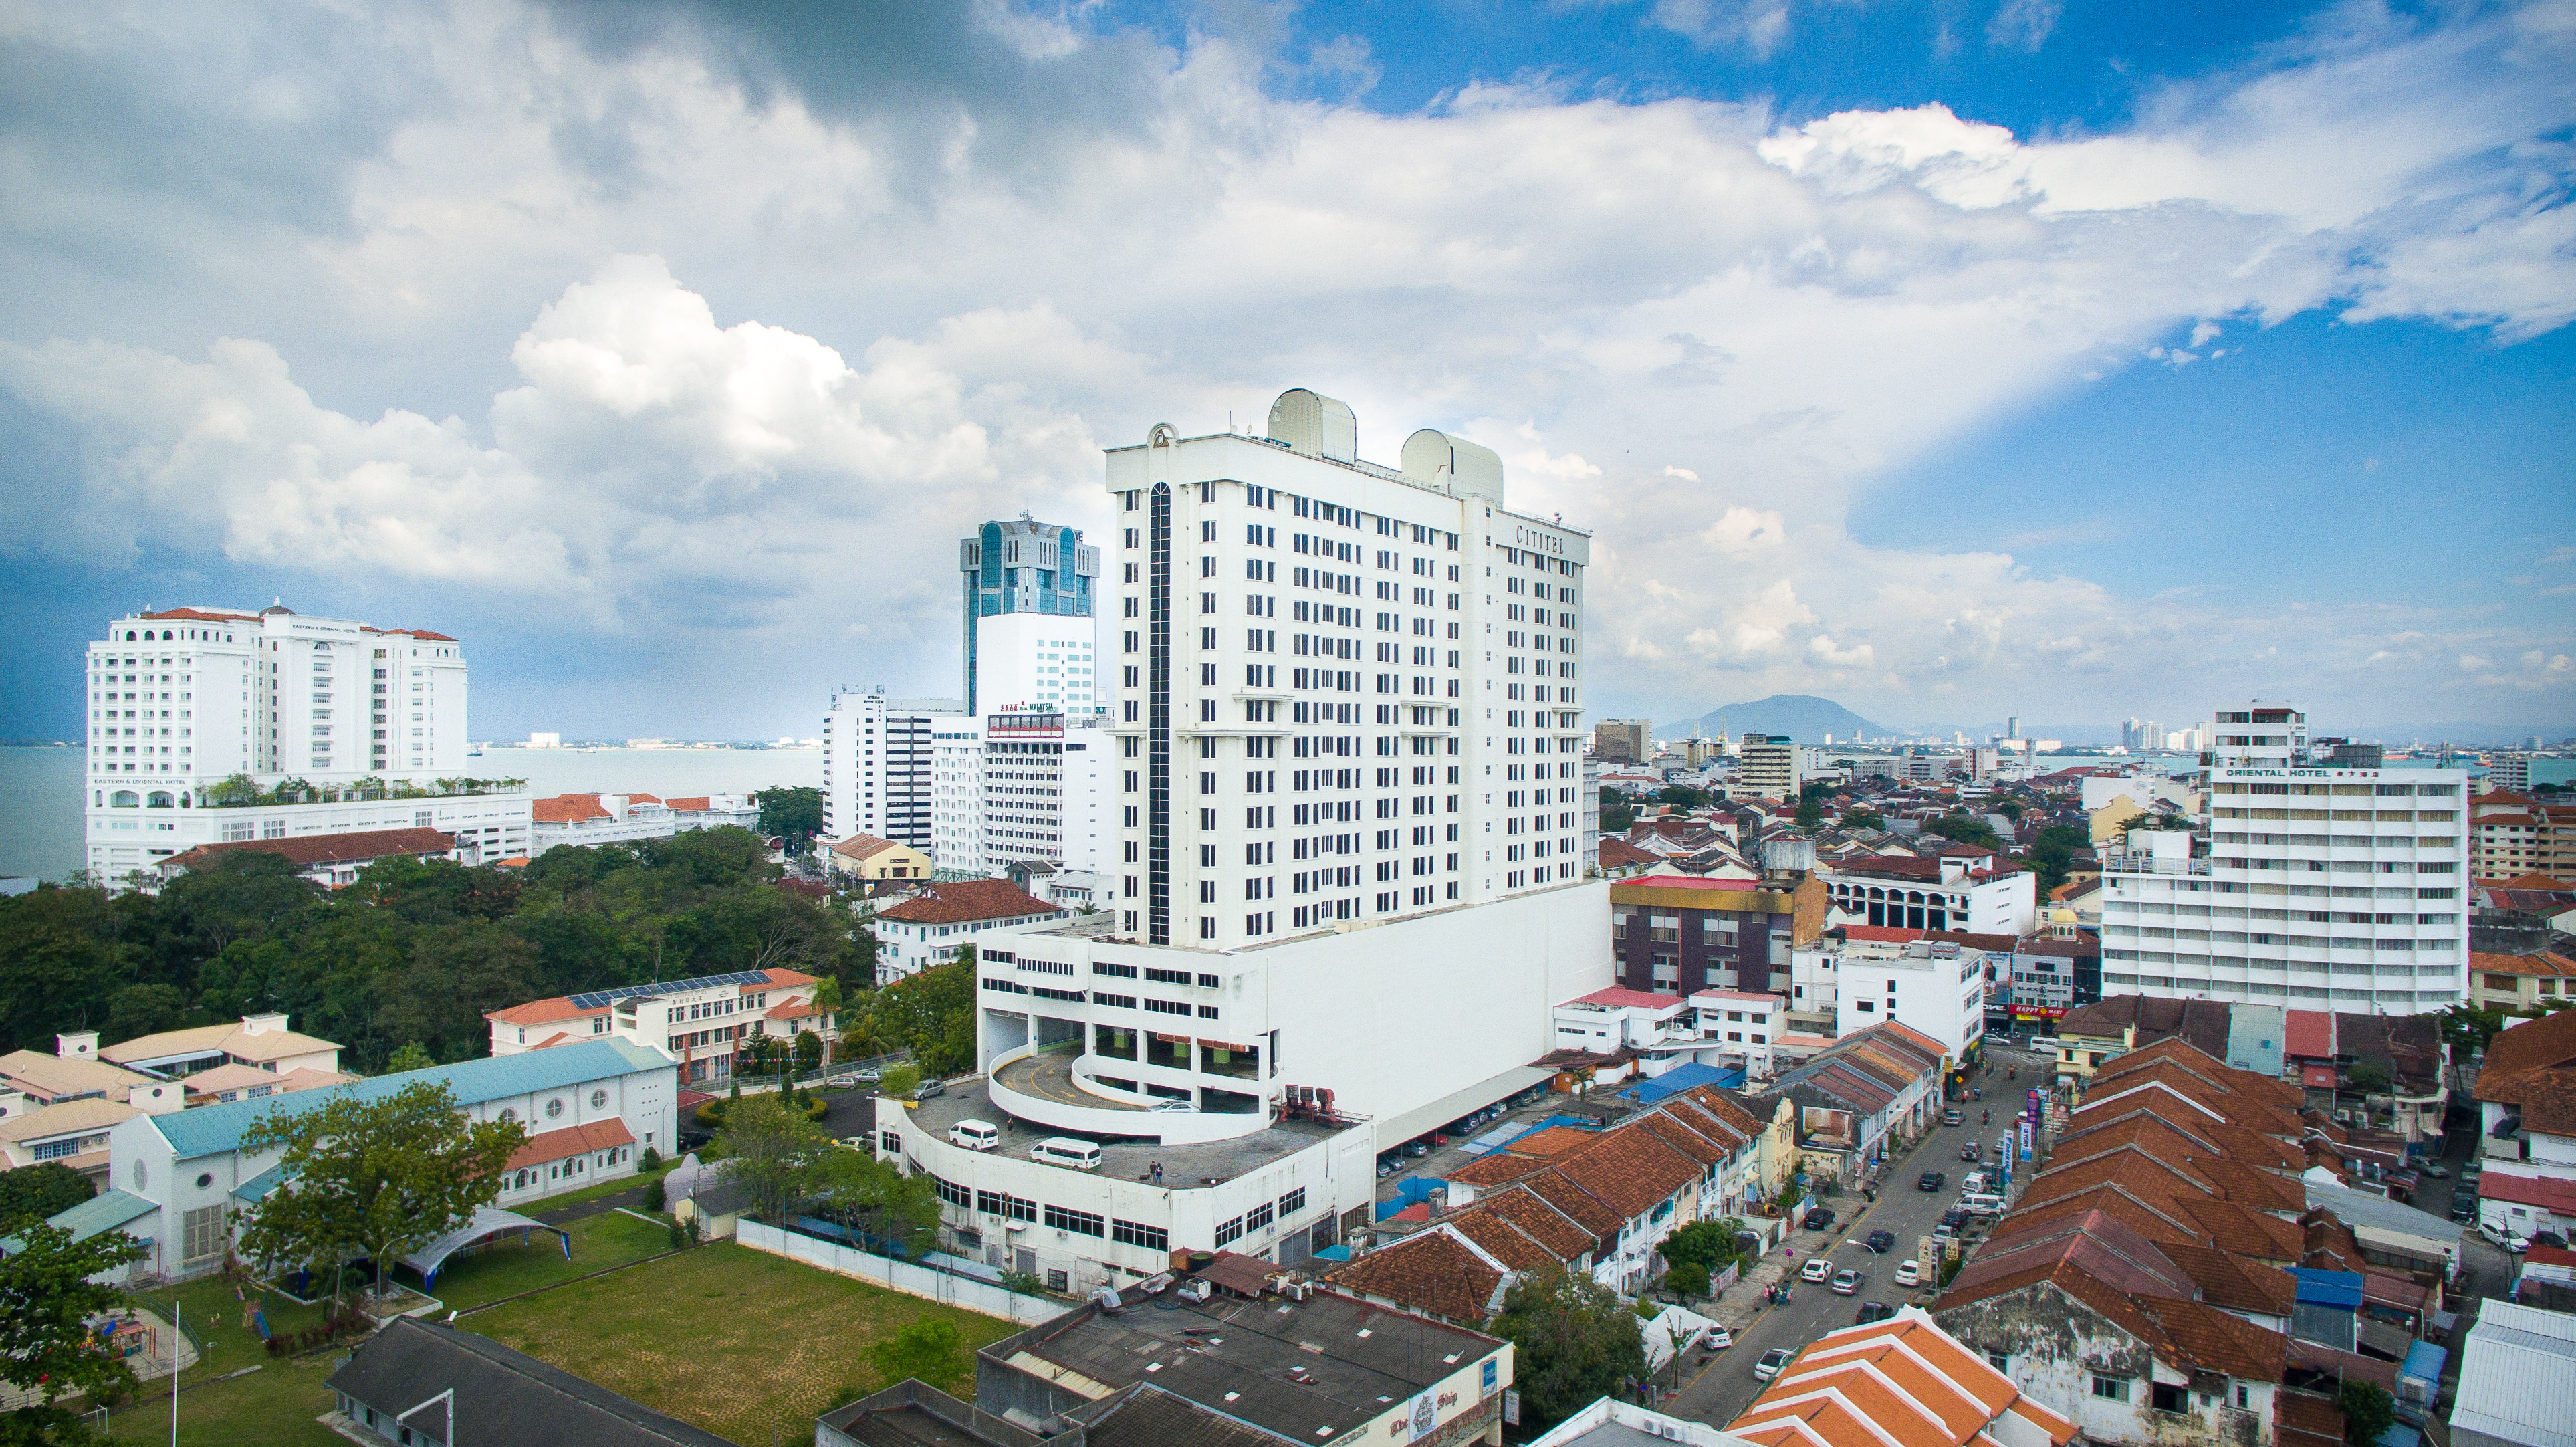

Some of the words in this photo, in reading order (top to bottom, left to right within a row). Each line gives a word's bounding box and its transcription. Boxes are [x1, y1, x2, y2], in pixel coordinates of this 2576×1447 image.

[1516, 525, 1564, 554] CITITEL
[2226, 769, 2285, 777] ORIENTAL
[2289, 770, 2331, 778] HOTEL
[1390, 1418, 1409, 1438] The
[1437, 1390, 1458, 1410] Ship
